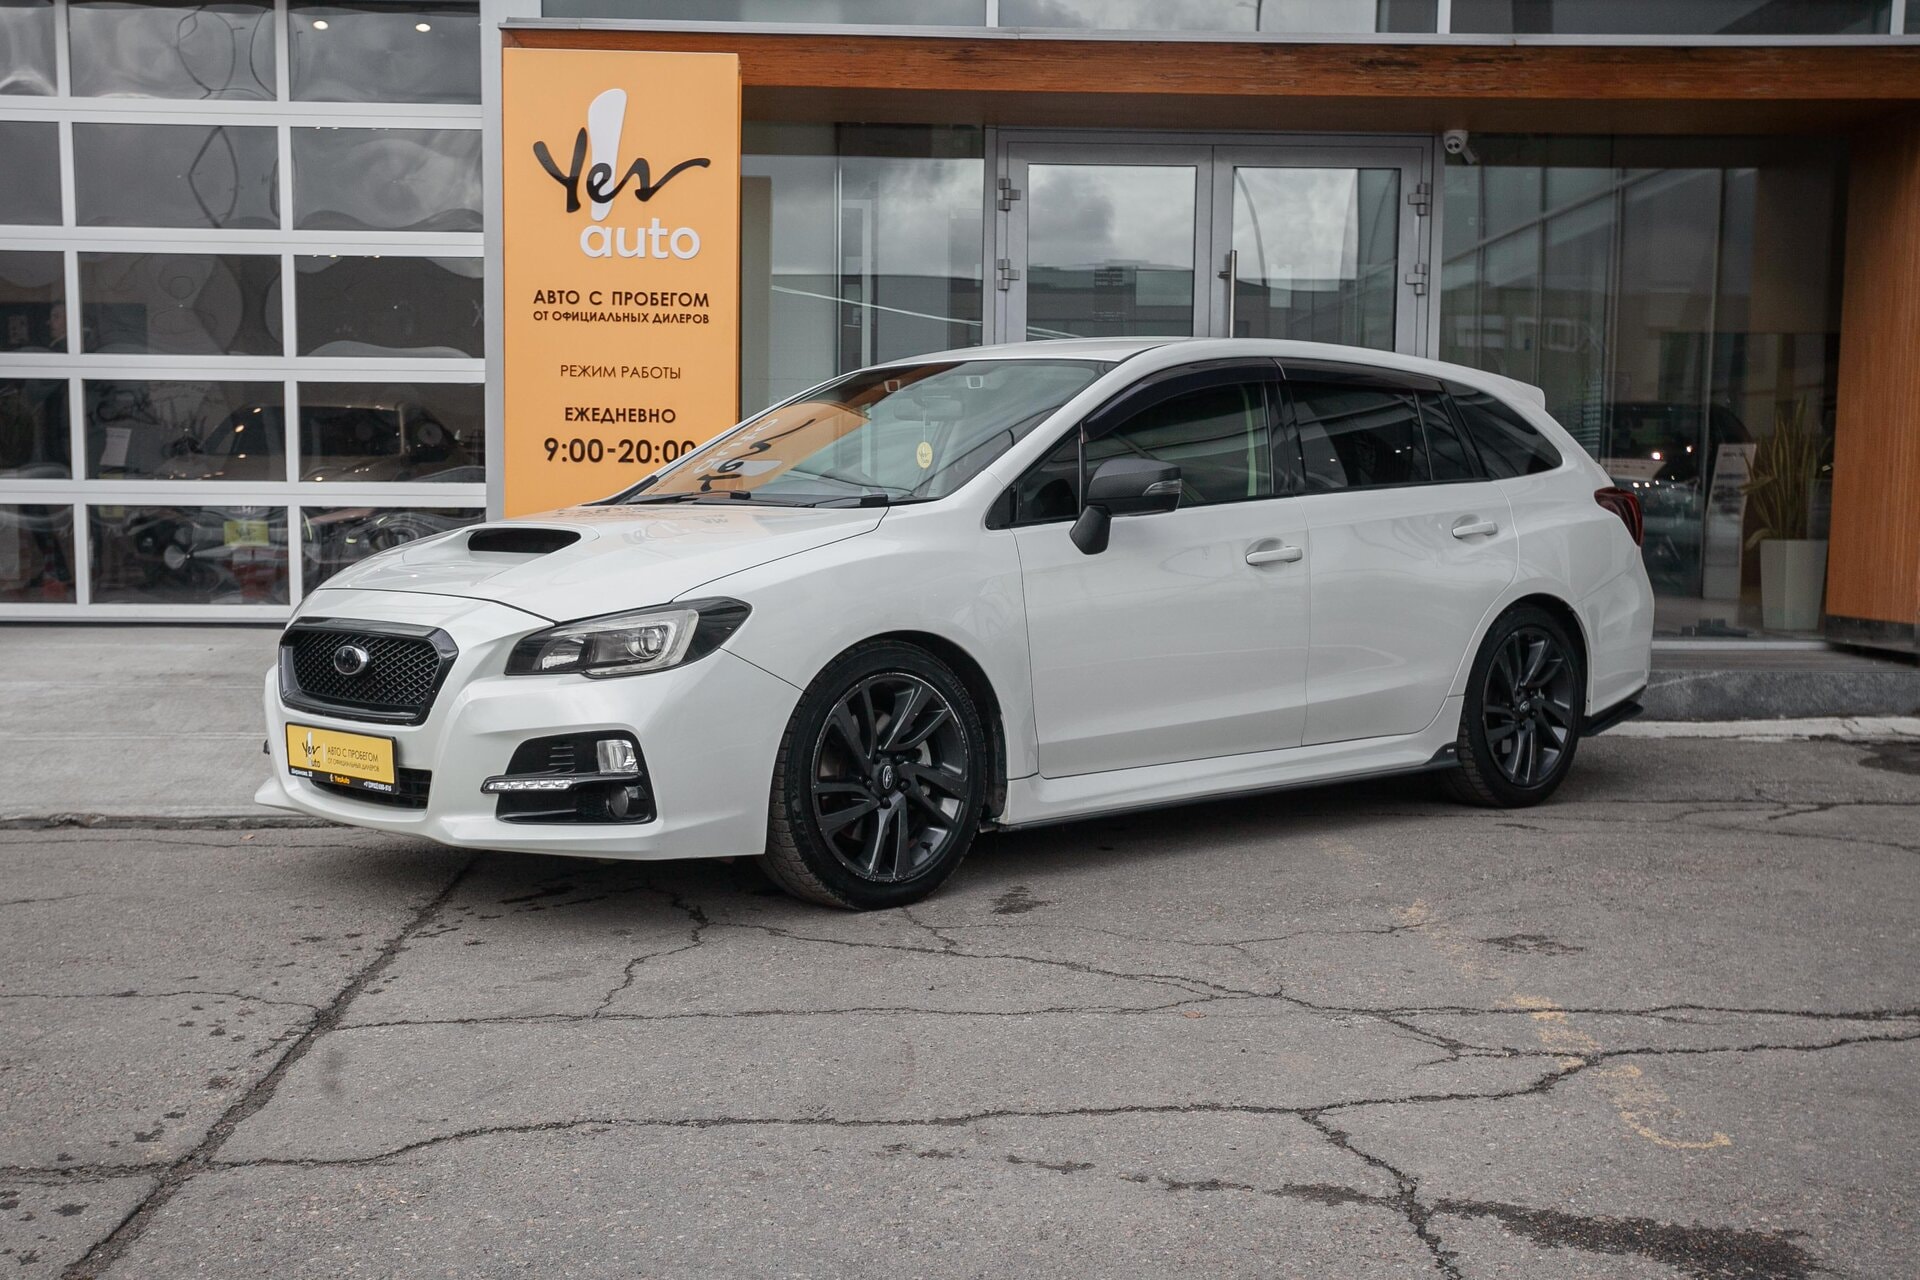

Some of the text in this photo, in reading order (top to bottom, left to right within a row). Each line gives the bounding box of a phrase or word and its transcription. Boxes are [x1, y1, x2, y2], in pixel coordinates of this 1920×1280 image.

[532, 127, 711, 213] Yes
[579, 218, 701, 260] auto
[533, 290, 710, 307] АВТО С ПРОБЕГОМ
[533, 311, 710, 324] ОТ ОФИЦИАЛЬНЫХ ДИЛЕРОВ
[560, 365, 681, 379] РЕЖИМ РАБОТЫ
[564, 407, 676, 424] ЕЖЕДНЕВНО
[327, 746, 378, 761] АВТО С ПРОБЕГОМ
